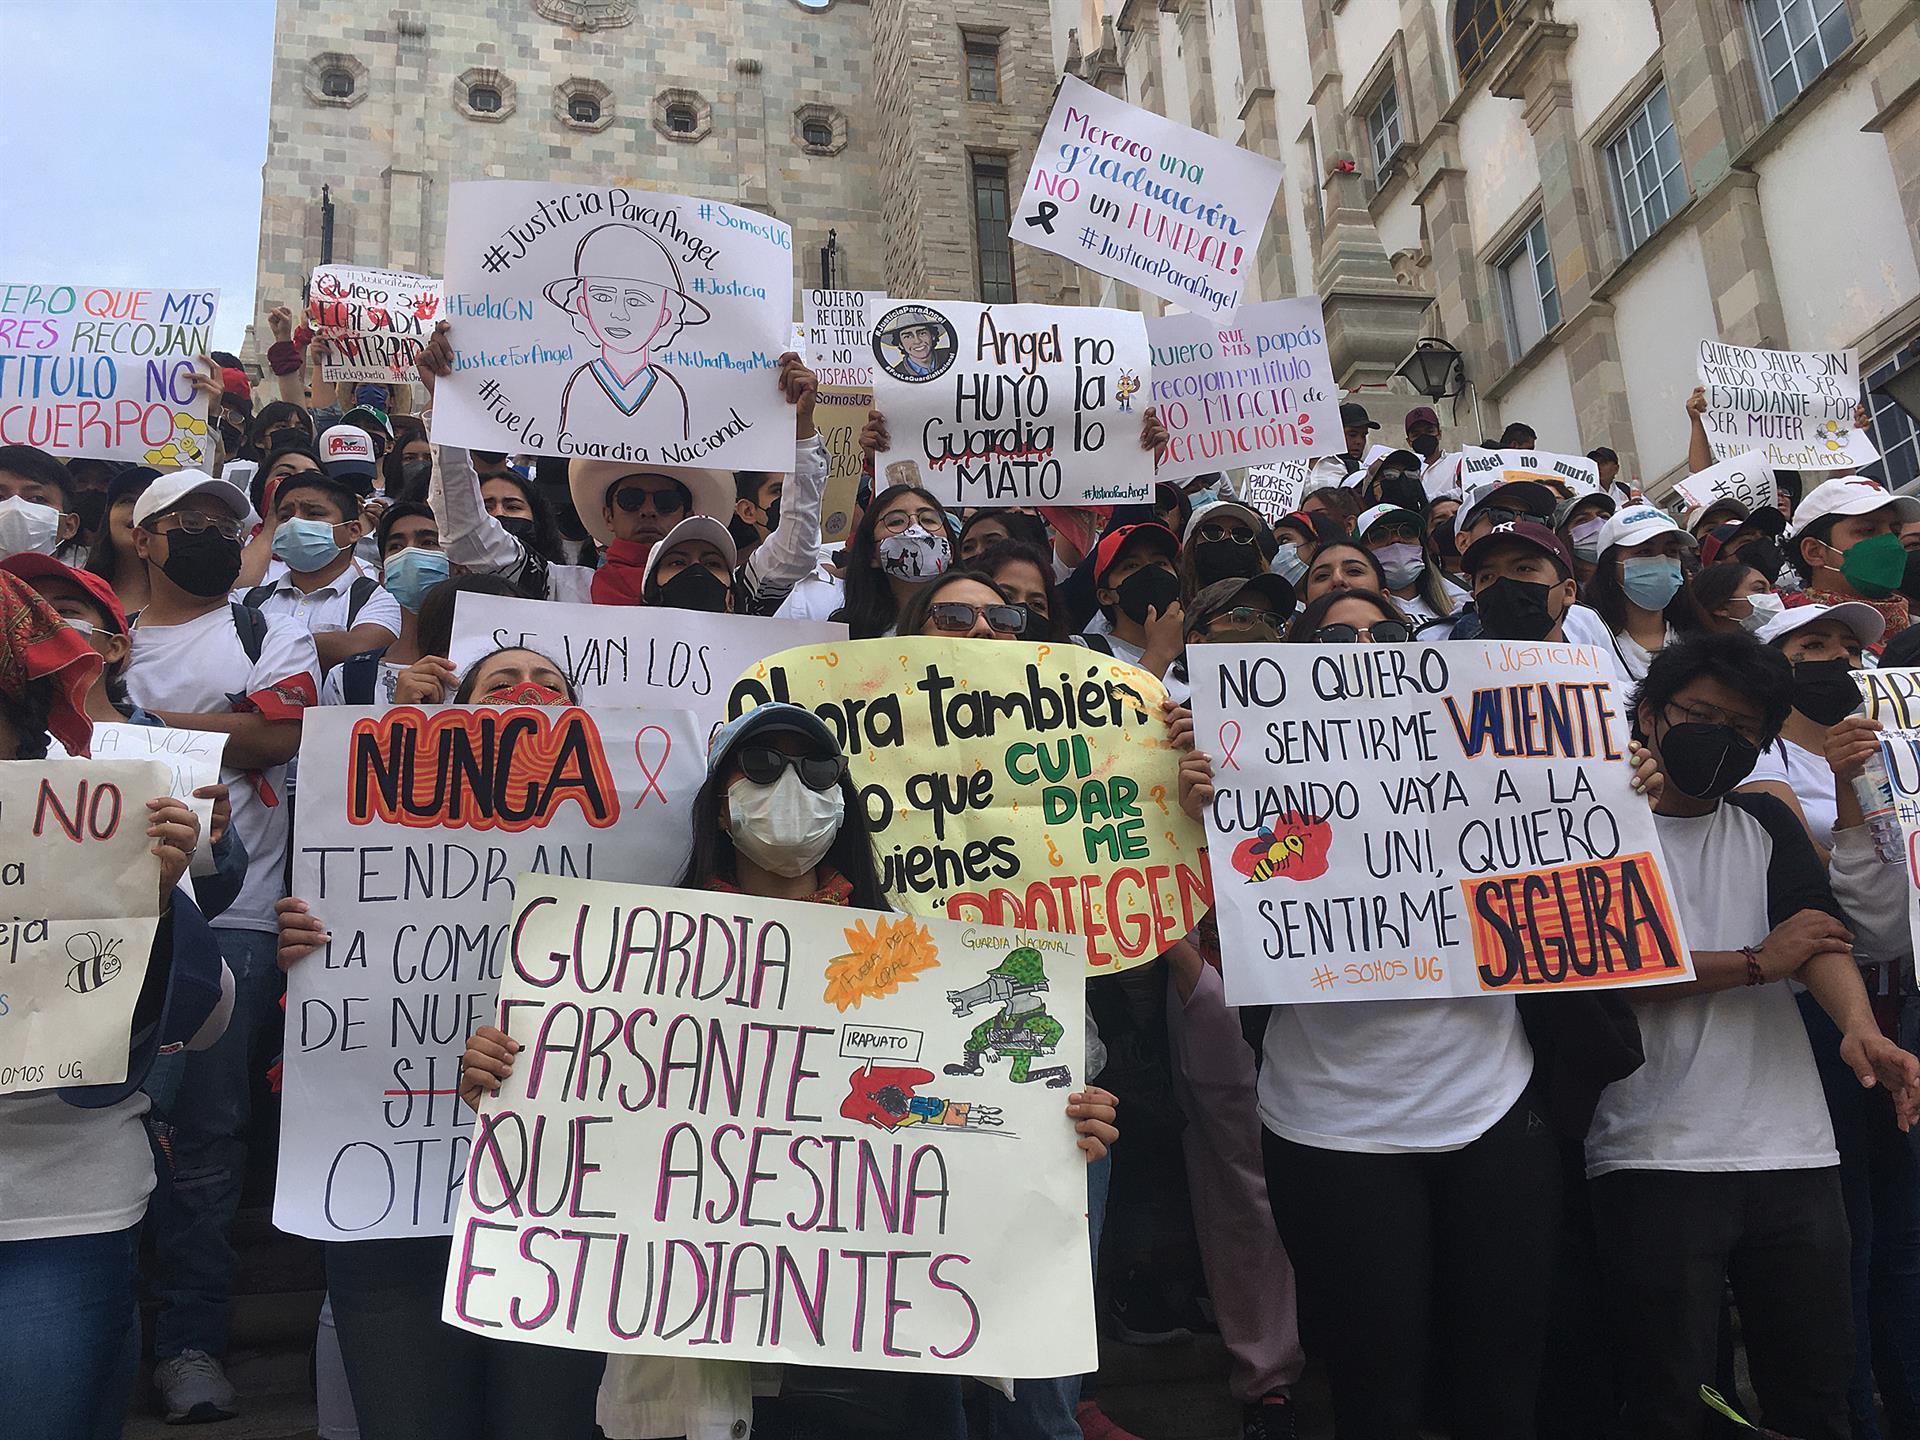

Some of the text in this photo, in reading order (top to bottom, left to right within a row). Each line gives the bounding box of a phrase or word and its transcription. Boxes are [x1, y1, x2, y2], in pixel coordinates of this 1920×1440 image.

[1063, 106, 1205, 184] Merezco una
[1056, 143, 1246, 236] graduación
[698, 204, 791, 249] #SomosUG
[1034, 169, 1244, 275] NO un FUNERAL!
[84, 288, 152, 321] QUE
[160, 292, 214, 326] MIS
[317, 273, 389, 304] Quiero
[444, 294, 533, 321] #FuelaGN
[691, 278, 766, 300] #Justicia
[812, 289, 864, 308] QUIERO
[71, 321, 210, 357] RECOJAN
[811, 330, 828, 345] MI
[817, 309, 866, 327] RECIBIR
[976, 305, 1115, 375] Ángel no
[1218, 329, 1244, 343] QUE
[1256, 325, 1322, 358] papás
[832, 349, 852, 364] NO
[1223, 344, 1251, 357] MIS
[1700, 339, 1848, 376] QUIERO SALIR SIN
[145, 358, 198, 406] NO
[956, 366, 1106, 423] HUYO la
[1151, 371, 1234, 402] recojan
[1704, 364, 1842, 396] MIEDO POR SER
[0, 399, 174, 448] CUERPO
[1204, 394, 1231, 425] MI
[1237, 387, 1298, 420] ACTA
[1303, 386, 1328, 404] de
[1707, 411, 1805, 441] SER MUJER
[557, 431, 650, 462] Guardia
[662, 408, 753, 464] Nacional
[923, 411, 1105, 461] Guardia lo
[956, 459, 1062, 502] MATO
[1249, 474, 1294, 496] PADRES
[1279, 461, 1306, 483] MIS
[1465, 453, 1504, 474] Ángel
[1520, 456, 1538, 468] no
[563, 635, 712, 696] VAN LOS
[1219, 657, 1287, 709] NO
[1312, 648, 1449, 701] QUIERO
[917, 664, 1148, 748] también
[1265, 682, 1624, 765] SENTIRME VALIENTE
[1868, 672, 1920, 730] AB
[355, 717, 607, 822] NUNCA
[1005, 734, 1092, 786] CUI
[32, 778, 122, 843] NO
[859, 768, 993, 841] o que
[1042, 775, 1144, 826] DAR
[1213, 765, 1598, 833] CUANDO VAYA A LA
[880, 836, 1021, 894] ienes
[1082, 818, 1151, 864] ME
[1458, 805, 1621, 877] QUIERO
[1258, 859, 1679, 988] SENTIRME SEGURA
[325, 930, 366, 969] LA
[511, 896, 791, 1011] GUARDIA
[1413, 956, 1445, 983] UG
[301, 992, 500, 1052] DE NUE
[846, 1031, 908, 1050] IRAPUATO
[58, 1060, 83, 1080] UG
[488, 999, 835, 1123] FARSANTE
[469, 1111, 950, 1235] QUE ASESINA
[455, 1217, 981, 1360] ESTUDIANTES
